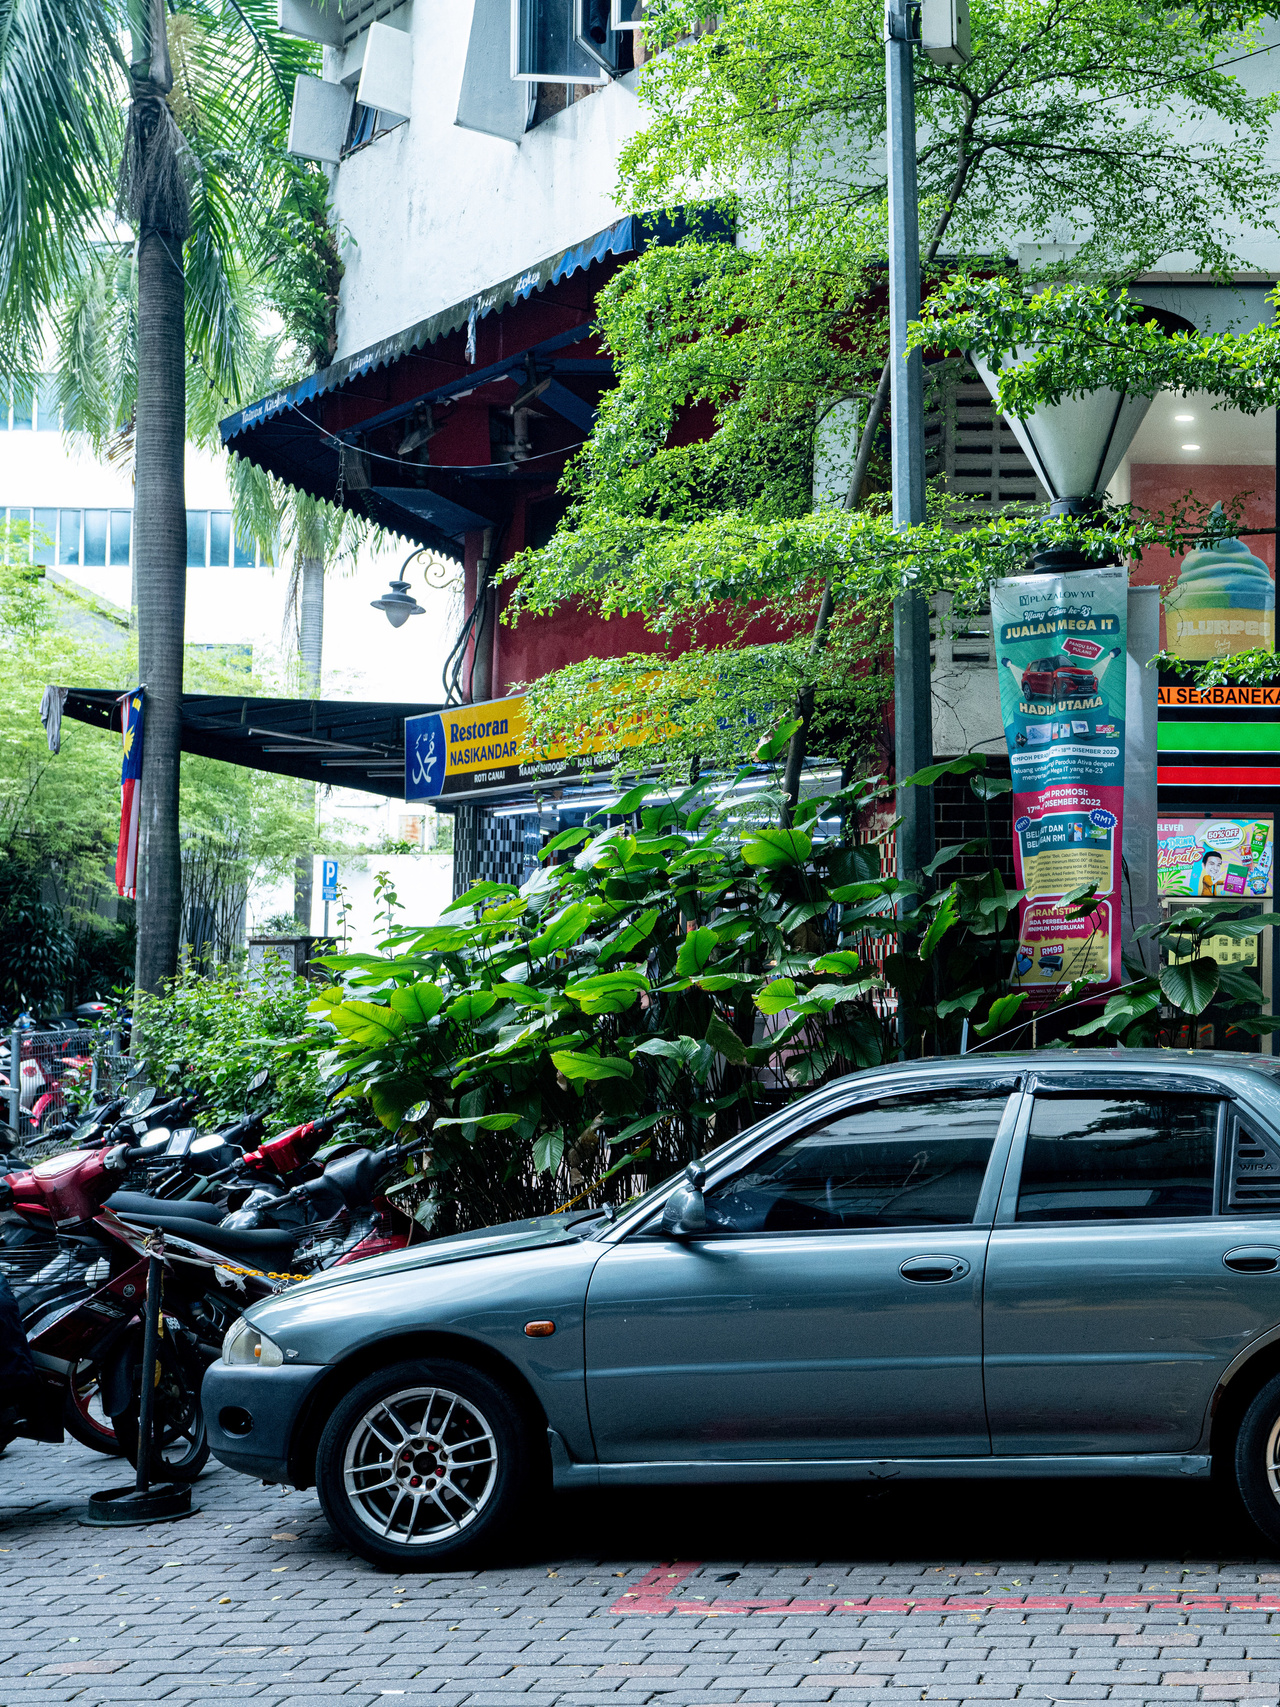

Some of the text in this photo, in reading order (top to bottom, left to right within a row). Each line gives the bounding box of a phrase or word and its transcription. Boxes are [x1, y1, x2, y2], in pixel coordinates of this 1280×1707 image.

[1080, 590, 1095, 599] YAT
[1005, 619, 1114, 640] JUALAN MEGA IT
[1068, 640, 1086, 649] PANDU
[1058, 696, 1104, 711] UTAMA
[450, 718, 509, 744] Restoran
[1077, 758, 1092, 767] Ativa
[1093, 760, 1115, 768] dengan
[474, 773, 487, 783] ROTI
[488, 770, 505, 781] CANAI
[1051, 789, 1088, 798] PROMOSI:
[1080, 798, 1101, 806] 2022
[1093, 812, 1112, 825] RM1
[1048, 824, 1064, 832] DAN
[1053, 834, 1066, 842] RM1
[1208, 828, 1240, 839] 50% OFF
[326, 862, 336, 886] P
[1050, 923, 1085, 932] DIPERLUKAN
[1041, 945, 1063, 956] RM99
[1239, 1163, 1274, 1171] WIRA
